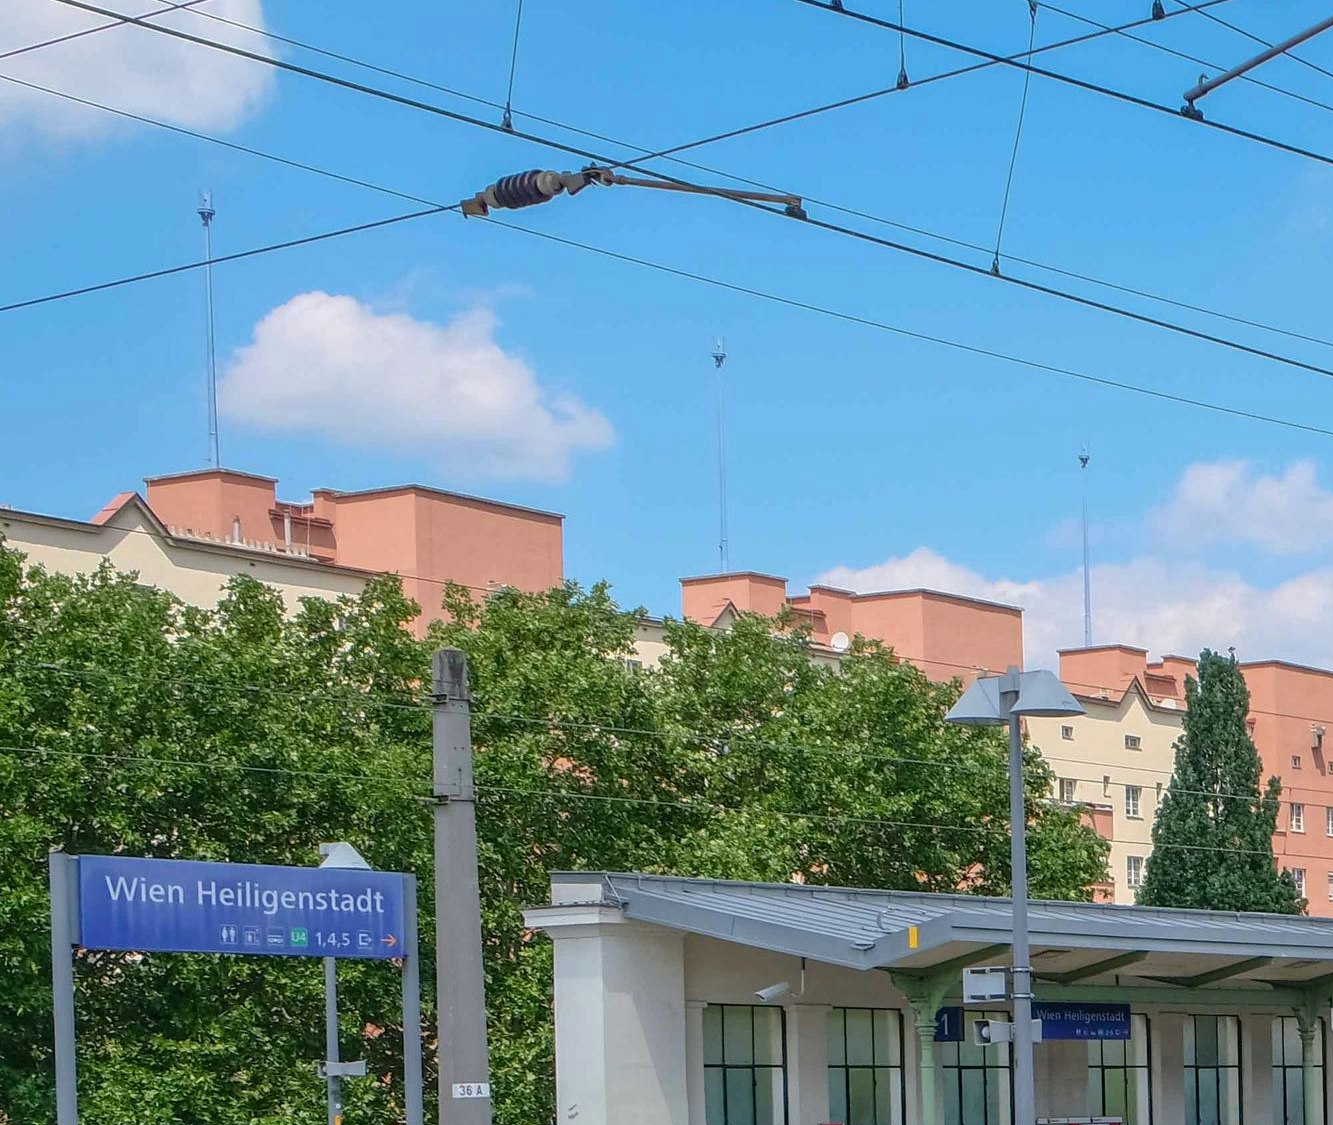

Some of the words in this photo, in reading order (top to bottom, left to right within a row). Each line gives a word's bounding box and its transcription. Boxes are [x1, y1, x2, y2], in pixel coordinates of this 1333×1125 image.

[104, 875, 184, 904] Wien
[197, 880, 385, 916] Heiligenstadt
[291, 930, 306, 942] U4
[941, 1013, 949, 1035] 1
[1036, 1009, 1061, 1021] Wien
[1064, 1010, 1125, 1024] Heiligenstadt
[459, 1085, 473, 1096] 36
[476, 1085, 484, 1096] A
